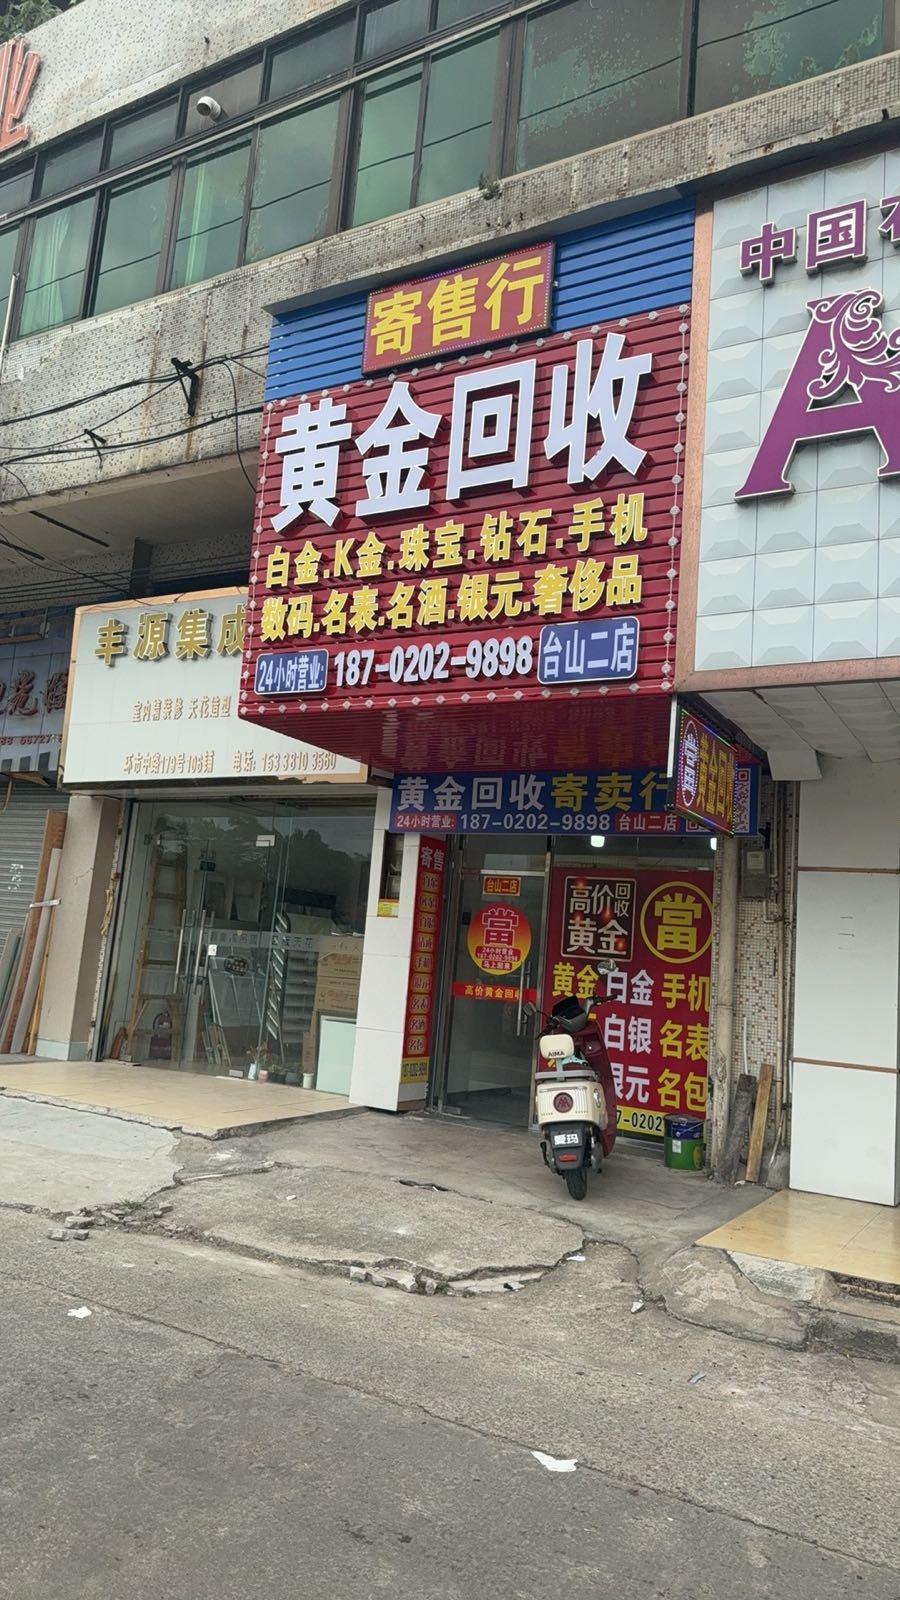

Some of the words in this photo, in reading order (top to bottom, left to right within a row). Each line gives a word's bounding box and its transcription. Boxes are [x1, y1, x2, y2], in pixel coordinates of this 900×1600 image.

[371, 256, 545, 356] 寄售行
[270, 332, 652, 533] 黄金回收
[94, 604, 246, 666] 丰源集成
[258, 655, 325, 692] 24小时营业:
[334, 635, 533, 687] 187-0202-9898
[543, 622, 635, 678] 台山二店
[460, 813, 610, 831] 187-0202-9898
[618, 813, 678, 831] 台山二店
[486, 879, 518, 893] 台山二店
[570, 884, 614, 915] 高价
[482, 907, 519, 947] 當
[566, 918, 628, 955] 黄金
[654, 892, 703, 953] 當
[552, 962, 599, 1000] 黄金
[606, 967, 655, 1007] 白金
[661, 973, 710, 1012] 手机
[603, 1013, 651, 1054] 白银
[658, 1020, 709, 1061] 名表
[657, 1068, 707, 1112] 名包
